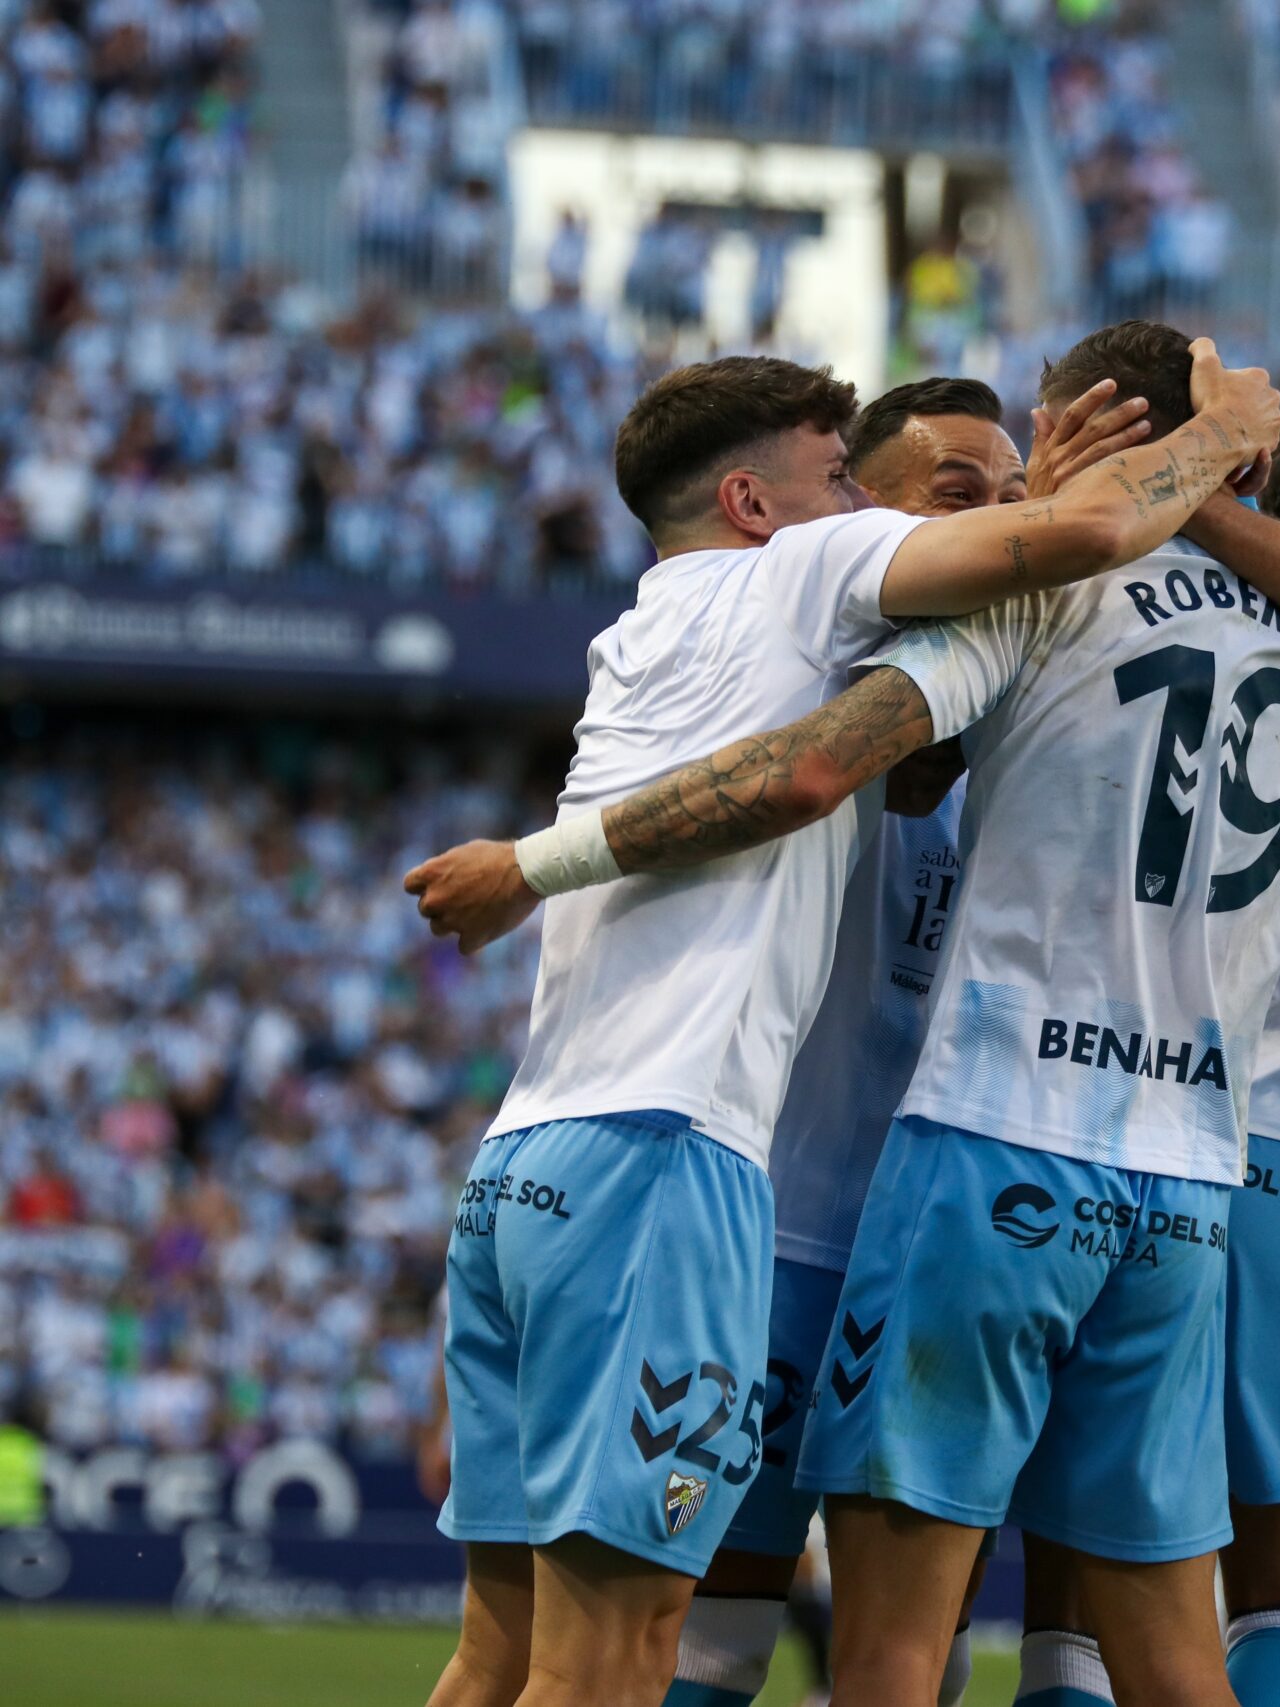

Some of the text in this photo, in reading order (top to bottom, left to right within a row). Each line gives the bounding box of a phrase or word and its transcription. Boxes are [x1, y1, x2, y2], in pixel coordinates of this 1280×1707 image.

[516, 1179, 571, 1220] SOL
[1147, 1210, 1204, 1244] DEL
[674, 1360, 766, 1486] 25
